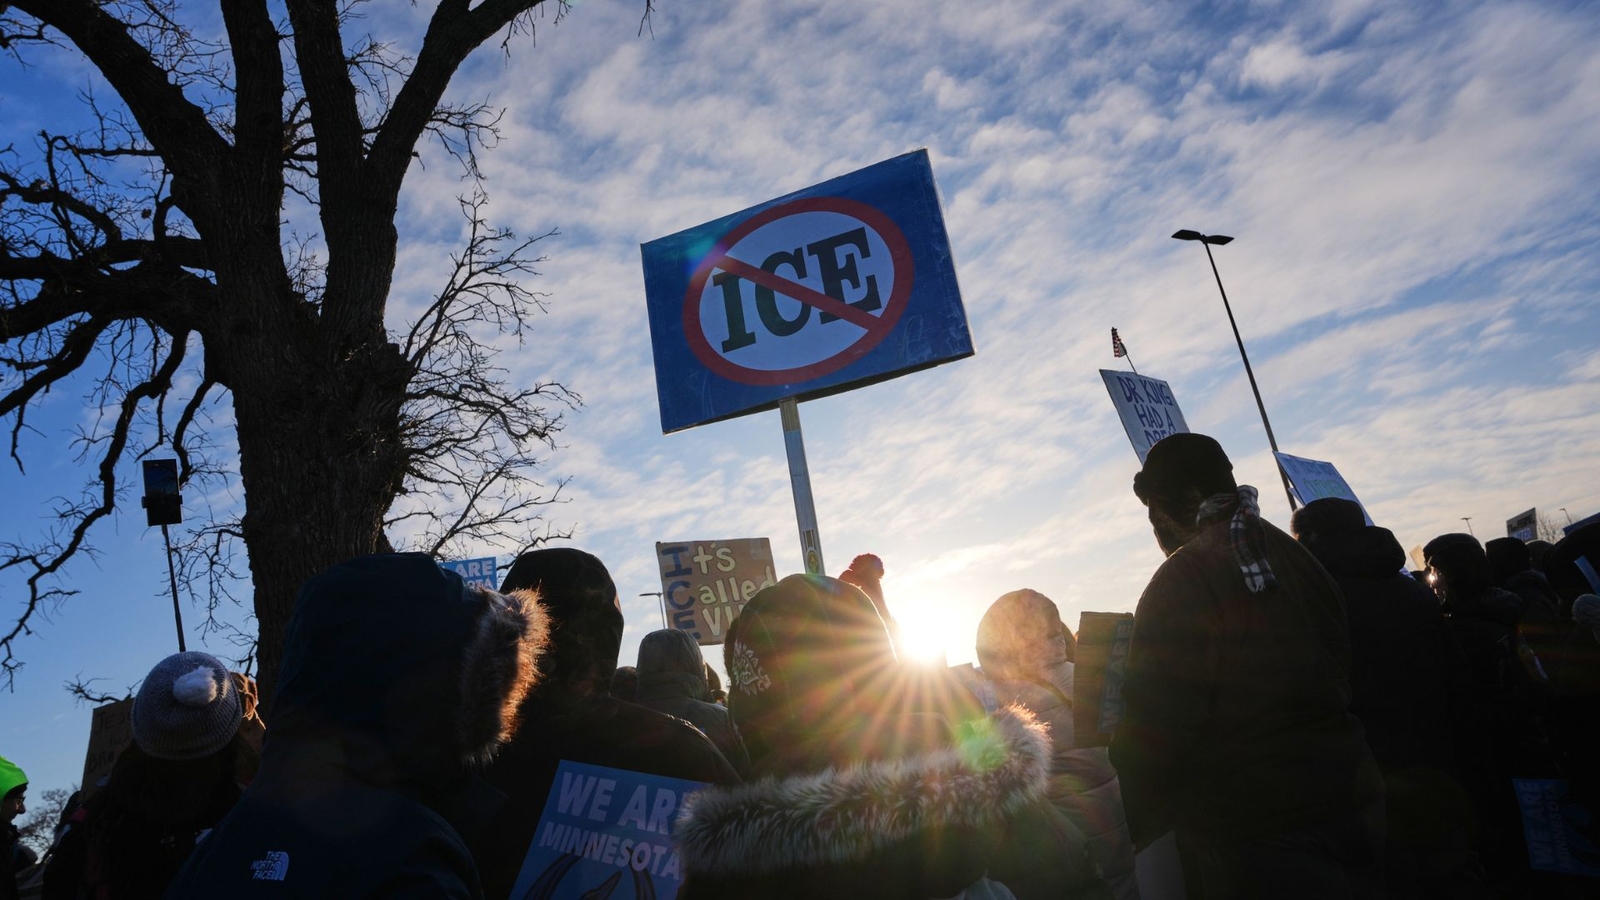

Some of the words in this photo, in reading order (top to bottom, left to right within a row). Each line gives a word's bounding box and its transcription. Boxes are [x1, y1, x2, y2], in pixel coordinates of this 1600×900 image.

[712, 226, 882, 354] ICE
[1116, 375, 1144, 403] DR
[1138, 379, 1173, 406] KING
[1134, 404, 1164, 429] HAD
[1164, 408, 1176, 432] A
[455, 560, 493, 578] ARE
[557, 771, 617, 822] WE
[1518, 781, 1546, 823] ARE
[266, 851, 281, 860] THE
[538, 821, 681, 880] MINNESOTA
[1529, 828, 1555, 865] WE
[250, 859, 276, 870] NORTH
[252, 870, 274, 880] FACE
